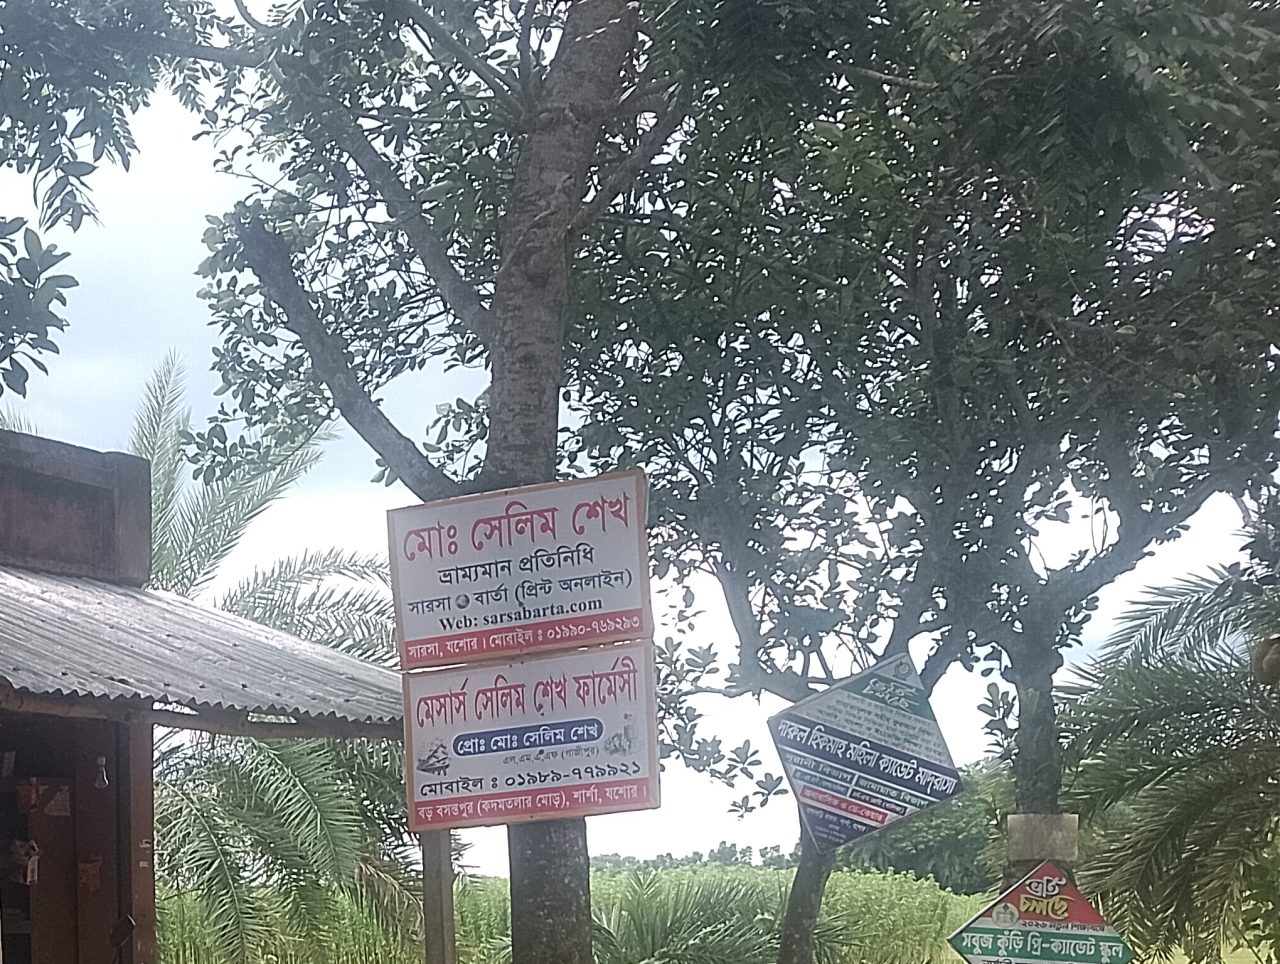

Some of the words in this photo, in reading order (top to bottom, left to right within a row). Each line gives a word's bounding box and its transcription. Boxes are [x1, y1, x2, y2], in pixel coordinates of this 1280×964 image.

[404, 521, 458, 562] মোঃ
[471, 501, 558, 550] সেলিম
[572, 491, 630, 535] শেখ
[438, 559, 512, 584] ভ্রাম্যমান
[519, 543, 594, 572] প্রতিনিধি
[408, 597, 451, 615] সারসা
[473, 583, 509, 605] বার্তা
[515, 579, 552, 604] (প্রিন্ট
[559, 569, 632, 592] অনলাইন)
[438, 616, 478, 631] Web:
[483, 598, 603, 627] sarsabarta.com
[408, 643, 443, 658] সারসা,
[489, 628, 533, 649] মোবাইল
[417, 677, 469, 728] মেসার্স
[475, 674, 526, 720] সেলিম
[534, 673, 567, 712] শেখ
[573, 656, 638, 707] ফার্মেসী
[490, 733, 518, 751] মোঃ
[523, 725, 564, 747] সেলিম
[570, 723, 598, 741] শেখ
[778, 721, 810, 745] দারুল
[808, 724, 848, 759] হিকমাহ
[847, 740, 880, 768] মহিলা
[879, 755, 918, 780] ক্যাডেট
[420, 776, 483, 797] মোবাইল
[505, 761, 641, 787] ০১৯৮৯-৭৭৯৯২১
[1026, 876, 1066, 897] ভর্তি
[1020, 894, 1075, 919] চলছে
[962, 932, 993, 955] সবুজ
[997, 930, 1024, 956] কুঁড়ি
[1026, 932, 1096, 956] প্রি-ক্যাডেট
[1099, 942, 1123, 963] স্কুল
